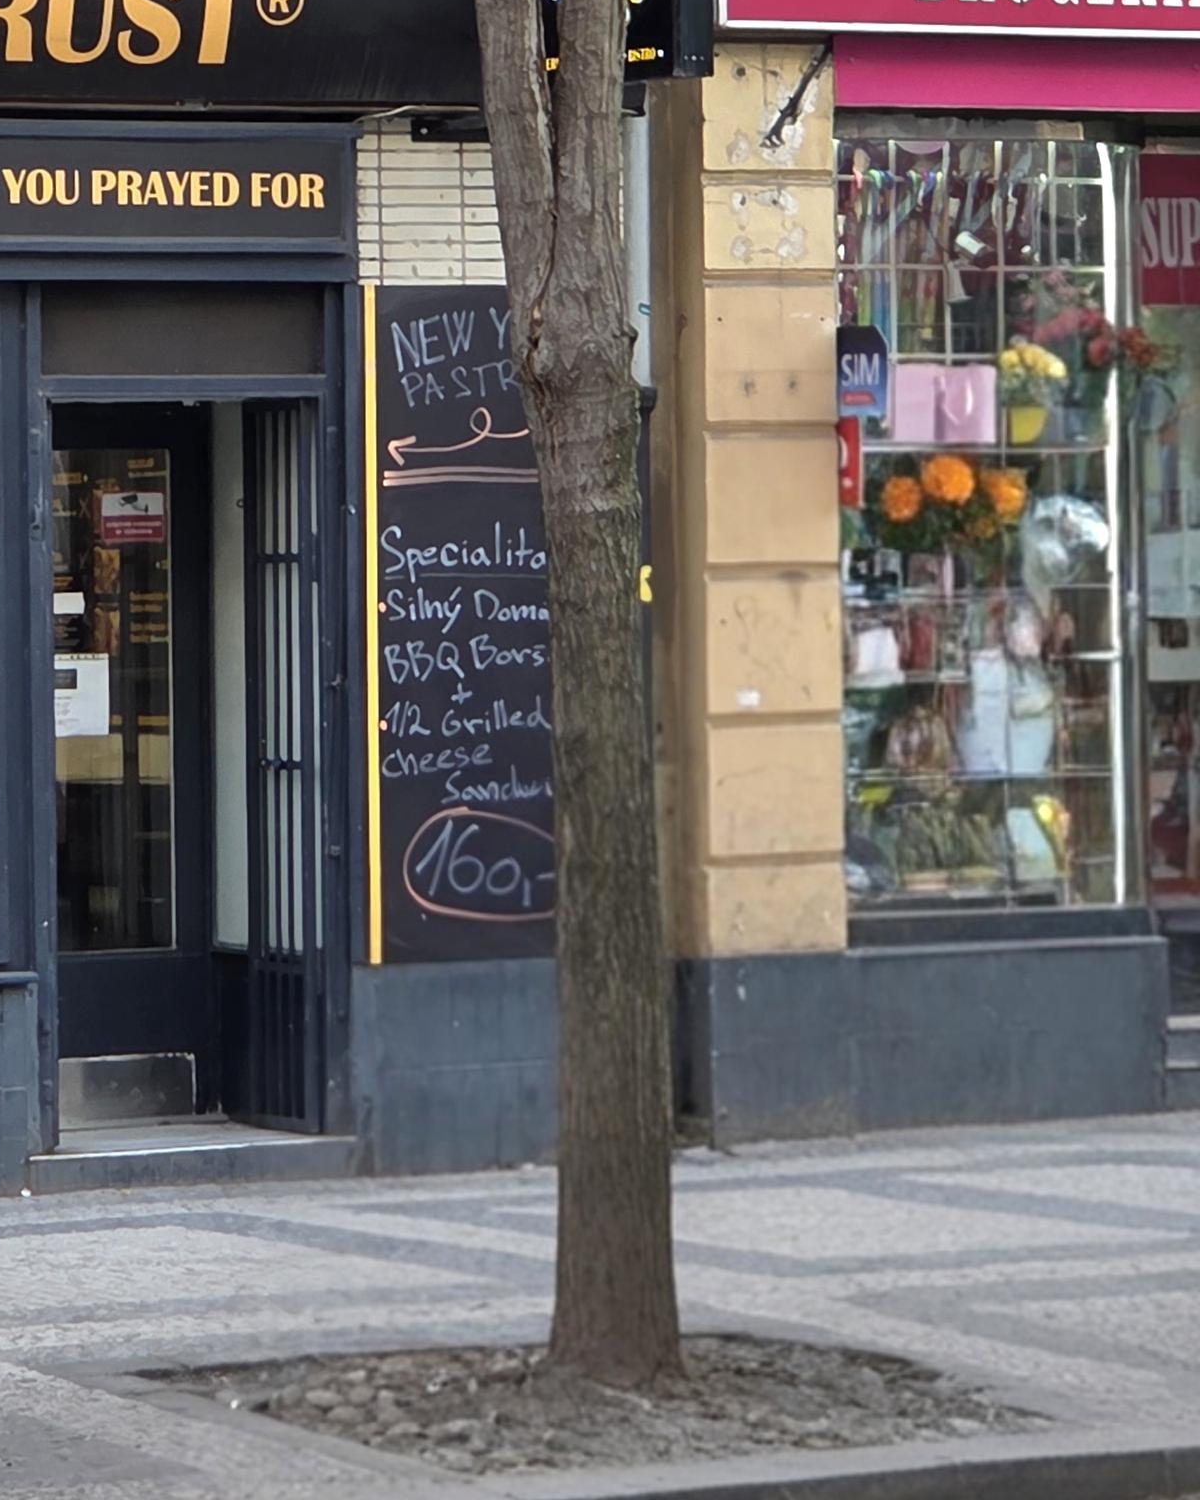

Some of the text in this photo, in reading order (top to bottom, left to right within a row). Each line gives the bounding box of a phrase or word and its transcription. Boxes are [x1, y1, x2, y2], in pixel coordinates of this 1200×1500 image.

[3, 169, 80, 204] YOU
[91, 169, 240, 207] PRAYED
[250, 171, 326, 209] FOR
[390, 309, 475, 373] NEW
[840, 353, 880, 387] SIM
[385, 585, 463, 634] Silný
[383, 639, 466, 684] BBQ
[384, 694, 552, 738] 1/2 Grilled
